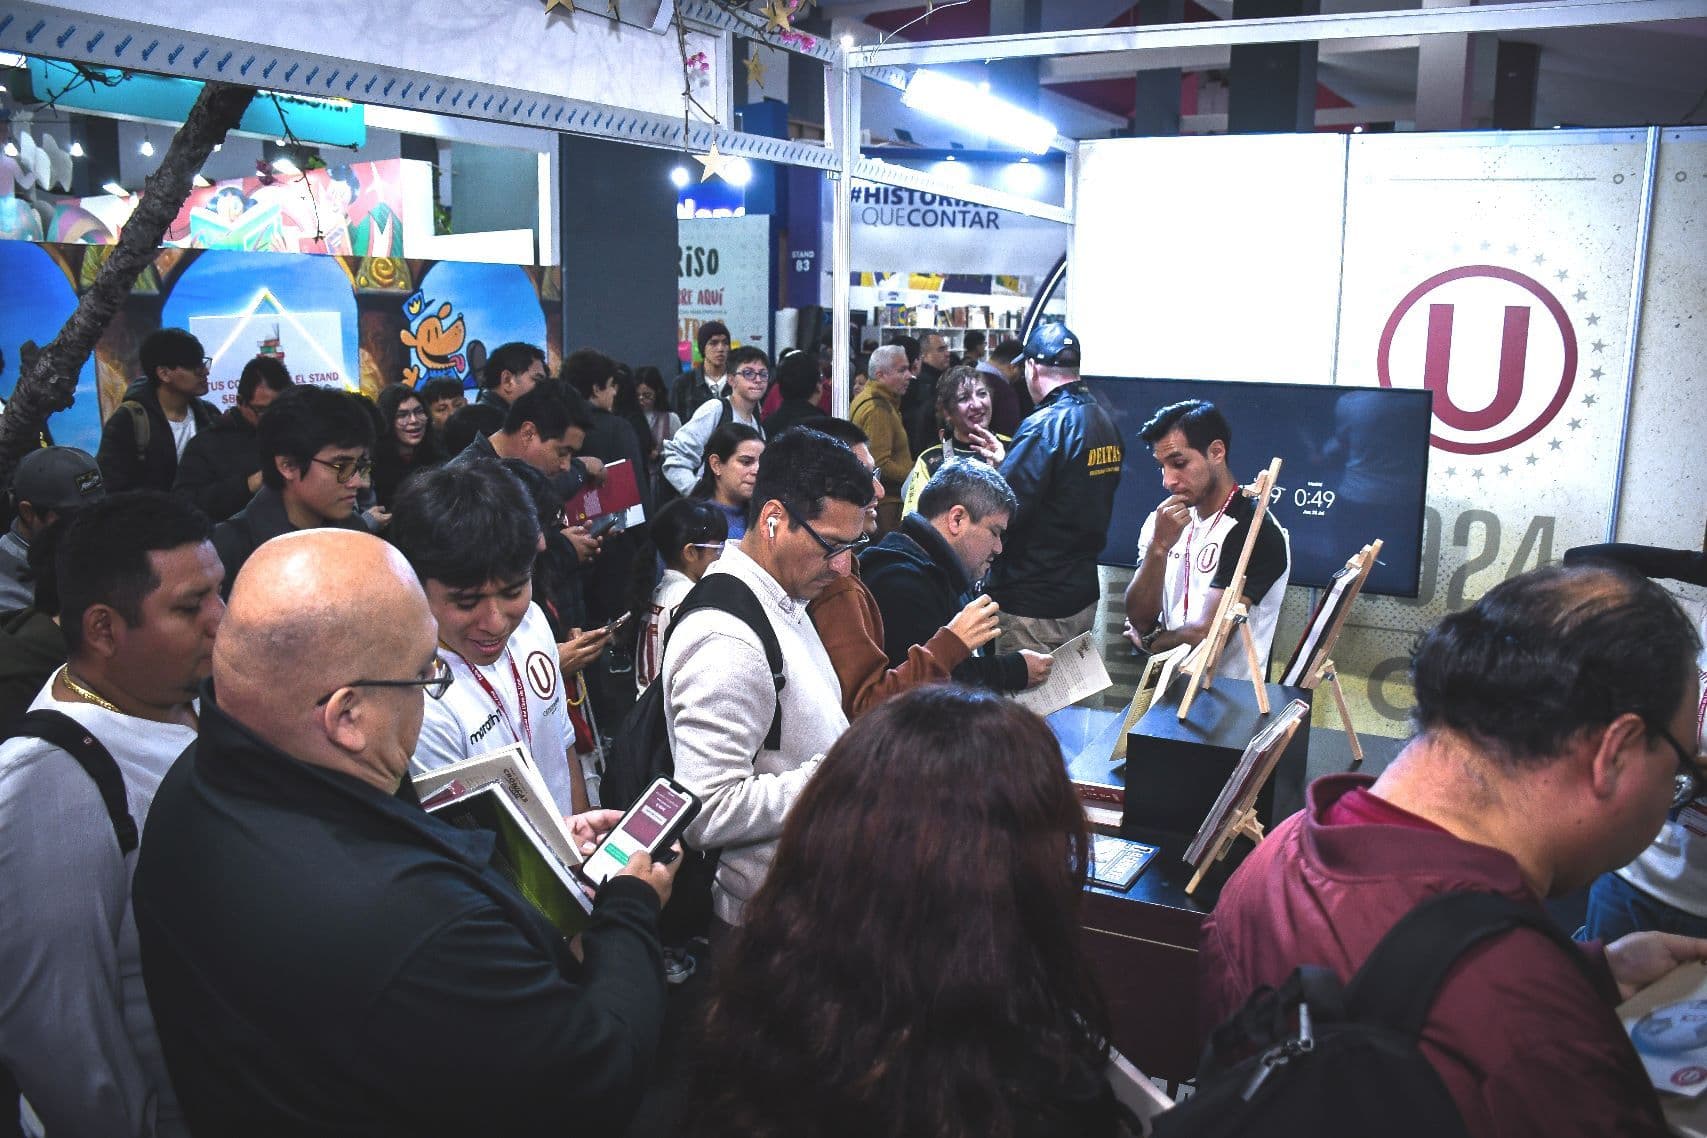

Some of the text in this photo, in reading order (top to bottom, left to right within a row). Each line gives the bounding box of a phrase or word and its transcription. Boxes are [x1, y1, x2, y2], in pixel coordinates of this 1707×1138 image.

[851, 186, 989, 207] #HISTOR
[861, 207, 1000, 229] QUECONTAR
[792, 251, 815, 259] STAND
[697, 287, 725, 306] AQUÍ
[1424, 303, 1531, 431] U
[227, 379, 241, 390] CO
[295, 374, 307, 384] EL
[309, 372, 339, 383] STAND
[1294, 488, 1335, 508] 0:49
